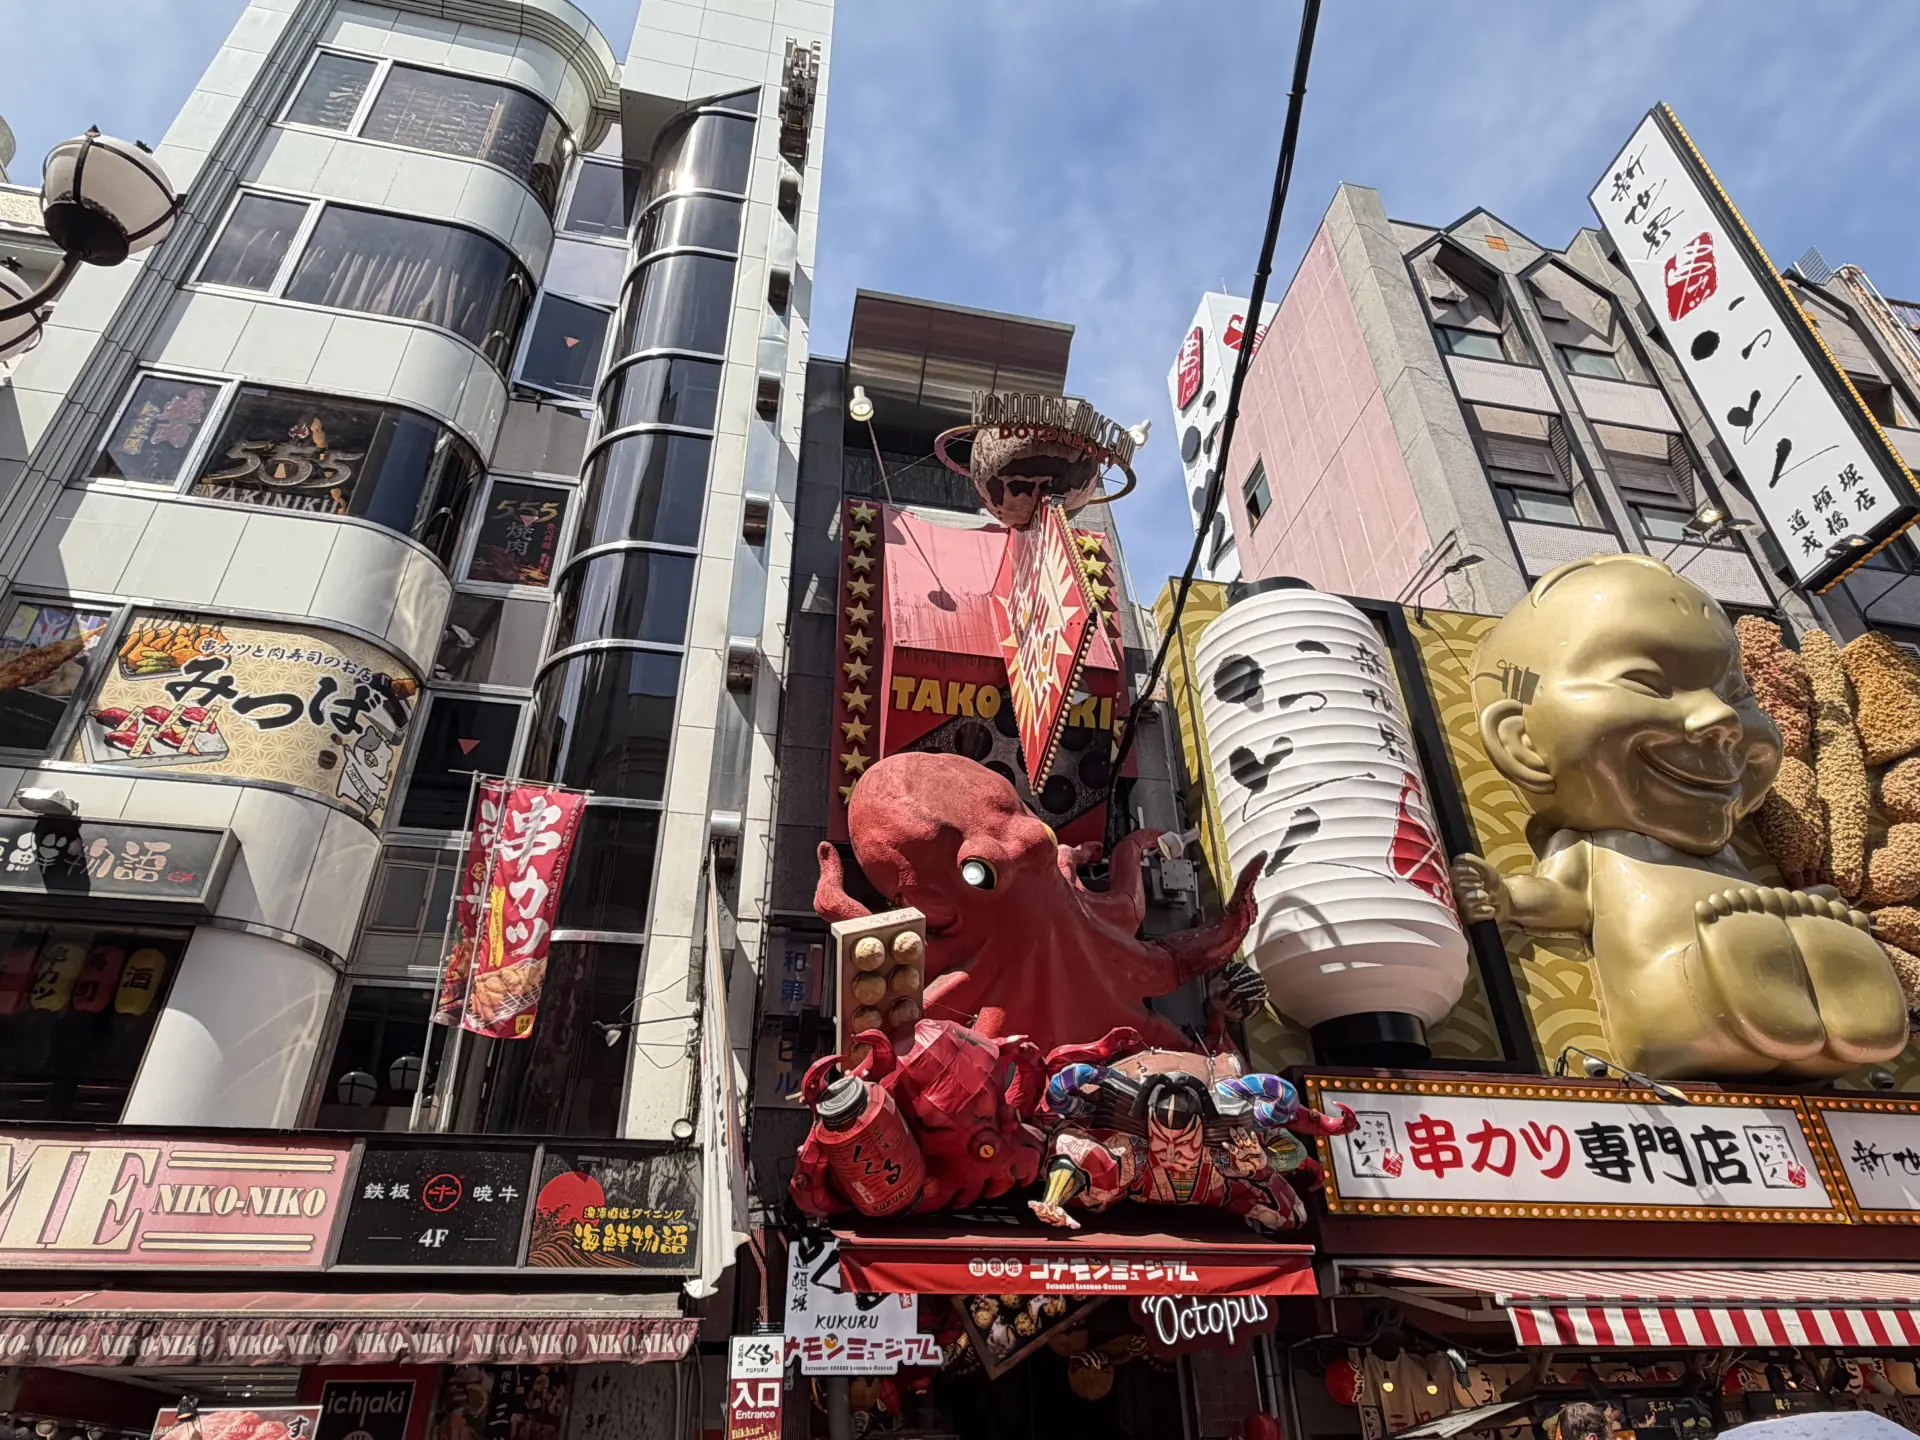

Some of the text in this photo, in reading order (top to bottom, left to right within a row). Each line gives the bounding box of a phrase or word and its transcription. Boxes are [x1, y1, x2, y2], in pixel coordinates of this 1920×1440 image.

[1610, 144, 1685, 260] 新世界
[971, 391, 1138, 466] KONAMON MUSEUM
[491, 500, 560, 523] 555
[1787, 463, 1865, 537] 道頓堀
[505, 521, 536, 556] 焼肉
[201, 639, 373, 684] 串カツと肉寿司のお店
[164, 656, 382, 735] みつば
[892, 676, 1113, 732] TAKOKI
[500, 796, 561, 956] 串カツ
[123, 965, 156, 990] 酒
[1404, 1112, 1753, 1187] 串カツ専門店
[151, 1184, 327, 1216] NIKO-NIKO
[363, 1183, 519, 1203] 鉄板 暁牛
[418, 1228, 449, 1248] 4F
[573, 1223, 688, 1254] 海鮮物語
[1030, 1257, 1199, 1281] コナモンミュージアム
[815, 1314, 879, 1329] KUKURU
[95, 1334, 215, 1357] NIKO-NIKO
[224, 1333, 338, 1356] NIKO-NIKO
[351, 1332, 461, 1354] NIKO-NIKO
[470, 1333, 578, 1355] NIKO-NIKO
[586, 1333, 690, 1354] NIKO-NIKO
[745, 1344, 774, 1366] くくる
[732, 1382, 780, 1409] 入口
[735, 1410, 776, 1420] Entrance
